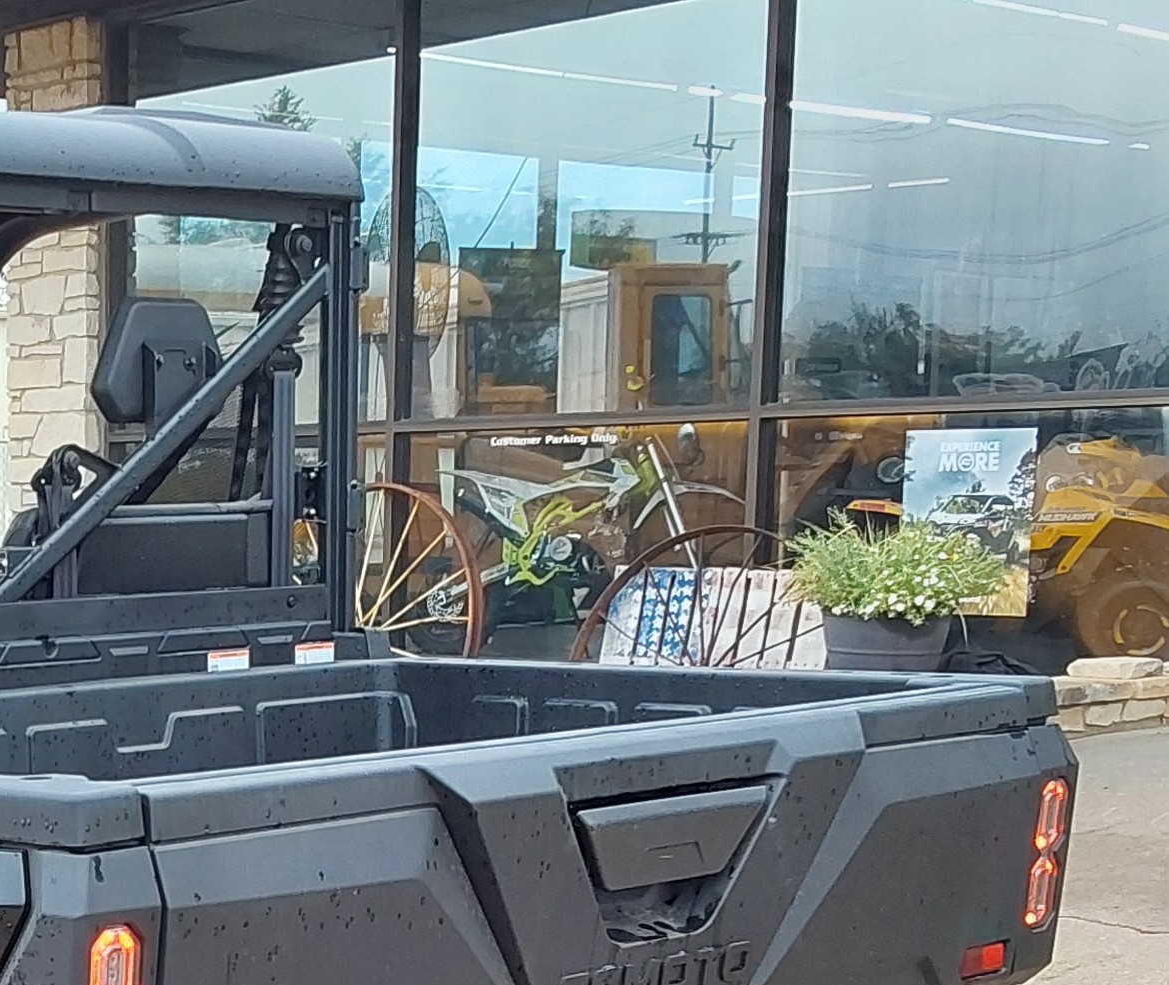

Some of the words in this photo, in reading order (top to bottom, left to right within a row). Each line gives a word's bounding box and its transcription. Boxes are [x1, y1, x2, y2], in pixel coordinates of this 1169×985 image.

[491, 437, 542, 447] Customer
[545, 434, 588, 445] Parking
[591, 433, 618, 444] Only
[940, 441, 1001, 452] EXPERIENCE
[938, 452, 1000, 472] MORE
